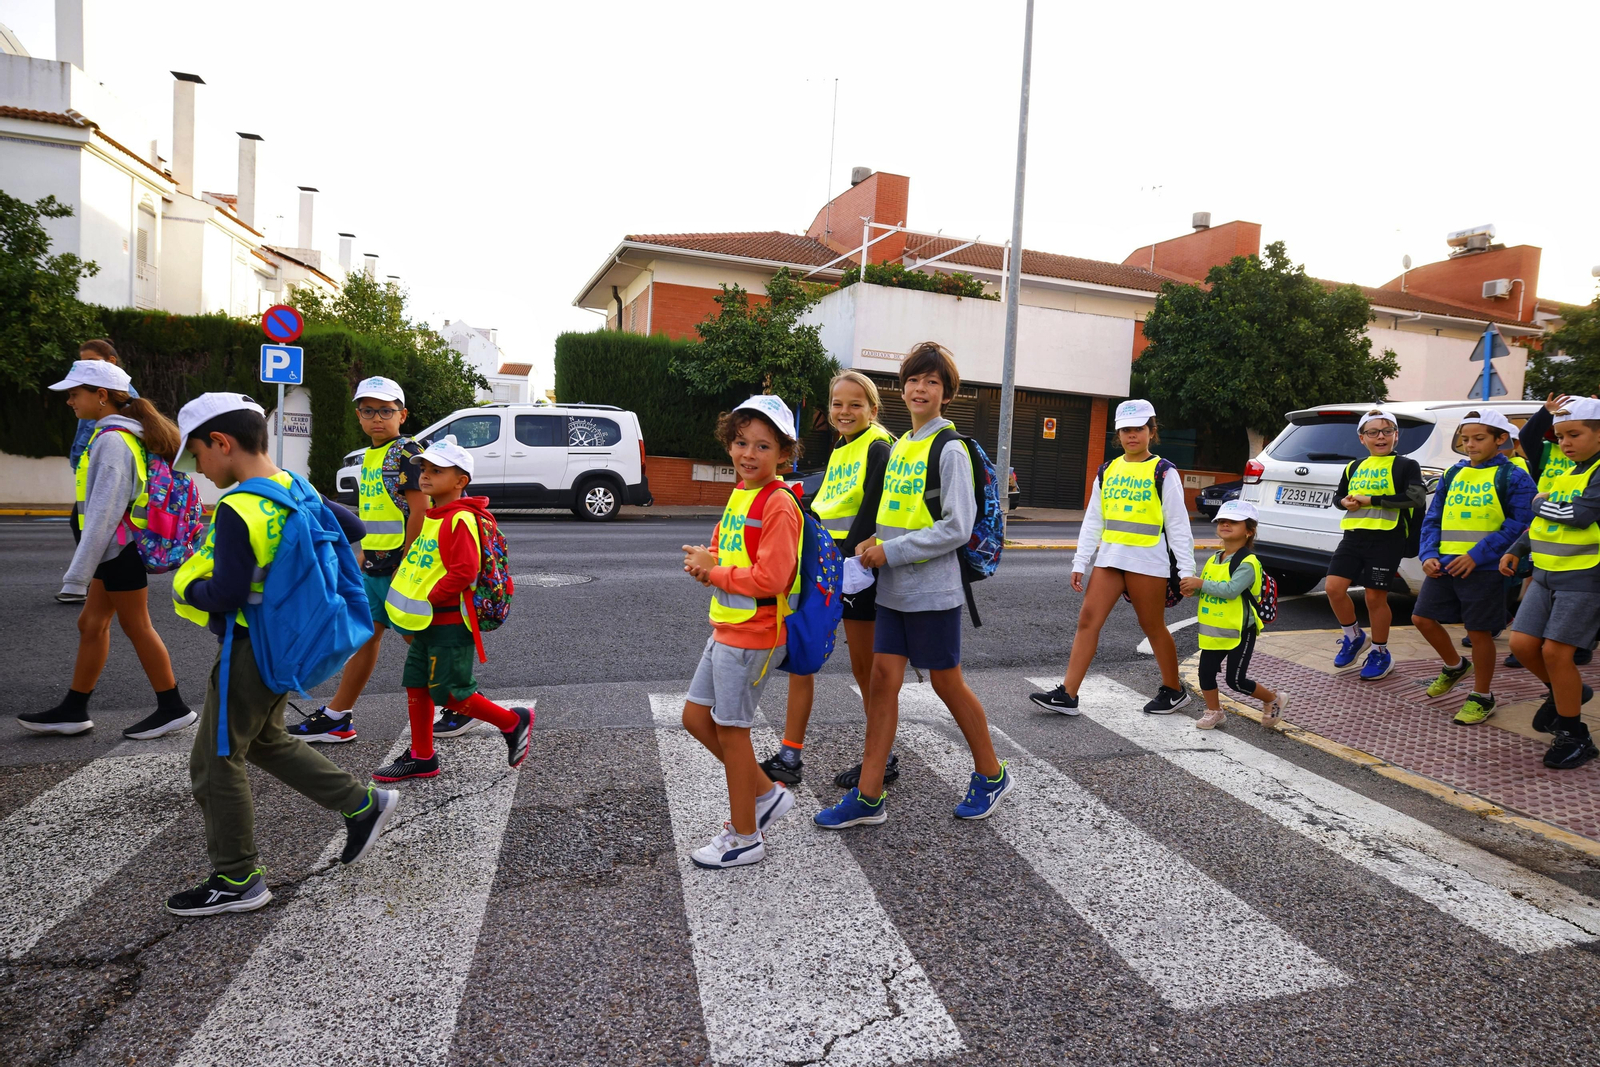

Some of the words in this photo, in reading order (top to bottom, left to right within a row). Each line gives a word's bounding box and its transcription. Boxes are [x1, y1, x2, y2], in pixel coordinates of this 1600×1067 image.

[265, 348, 290, 378] P
[282, 425, 308, 433] AMPANA
[828, 461, 861, 482] AMiNO
[1349, 478, 1389, 491] SCOLaR
[1282, 488, 1306, 501] 7239
[1308, 490, 1330, 505] HZM
[429, 656, 437, 681] 7
